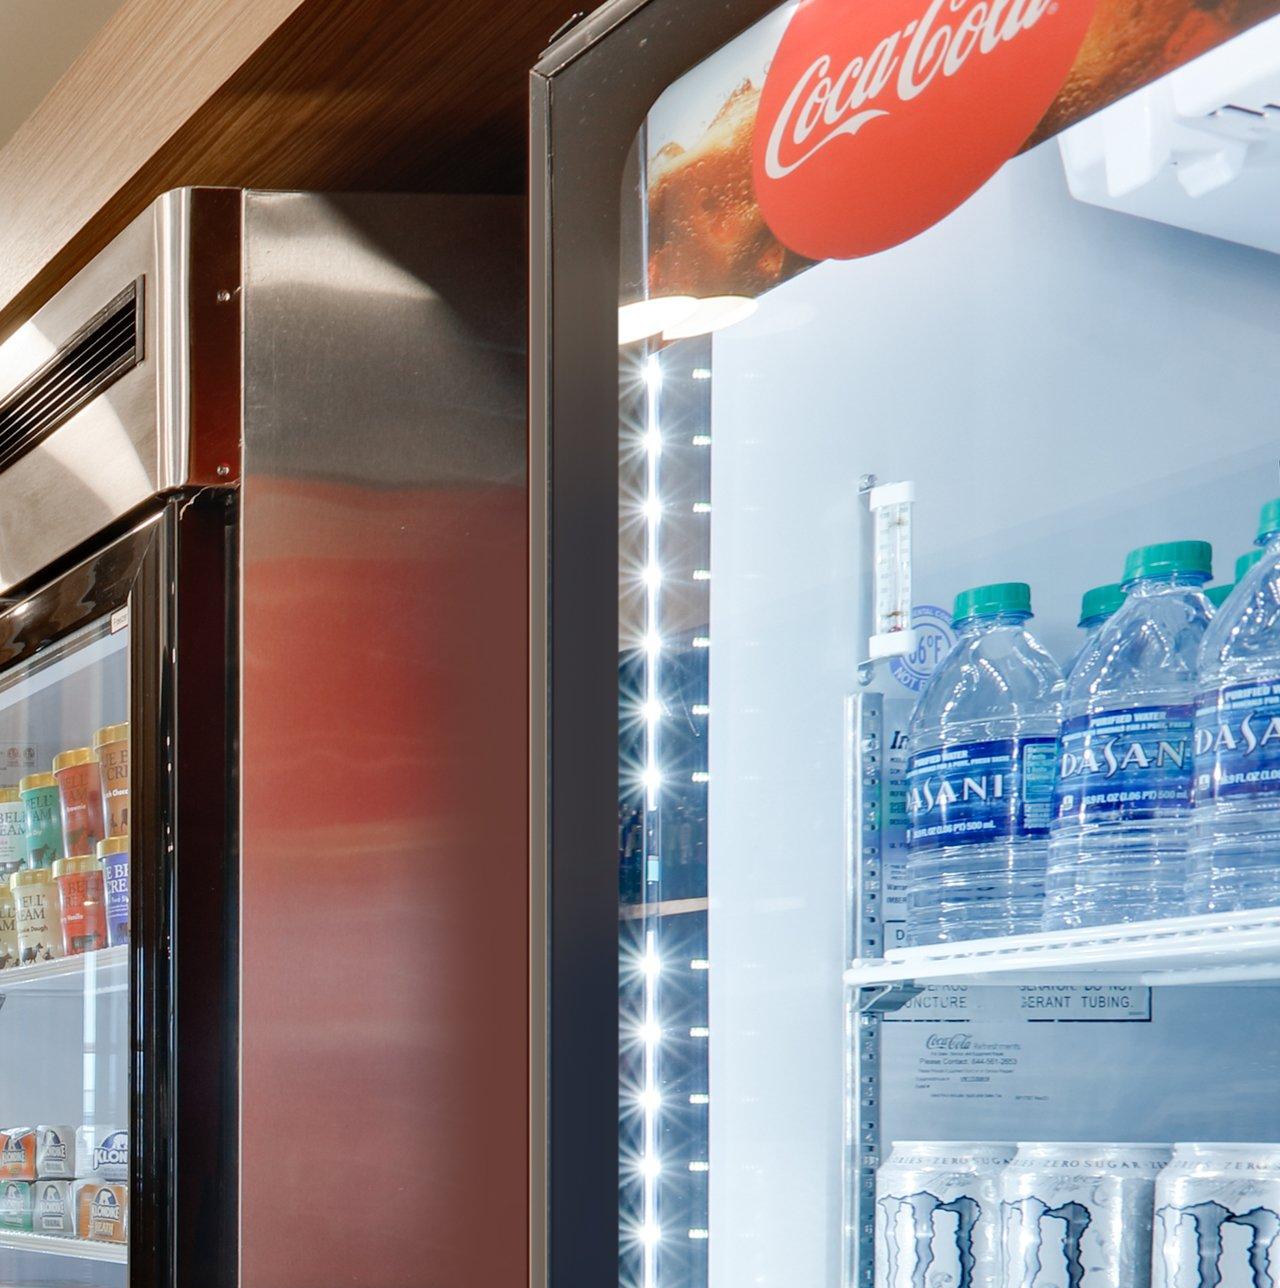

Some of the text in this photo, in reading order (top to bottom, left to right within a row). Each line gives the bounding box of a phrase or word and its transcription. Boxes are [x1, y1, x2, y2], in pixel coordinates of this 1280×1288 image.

[1134, 711, 1167, 721] WATER
[1081, 996, 1134, 1009] TUBING.
[919, 1057, 941, 1066] Please
[1043, 1159, 1142, 1170] ZERO SUGAR
